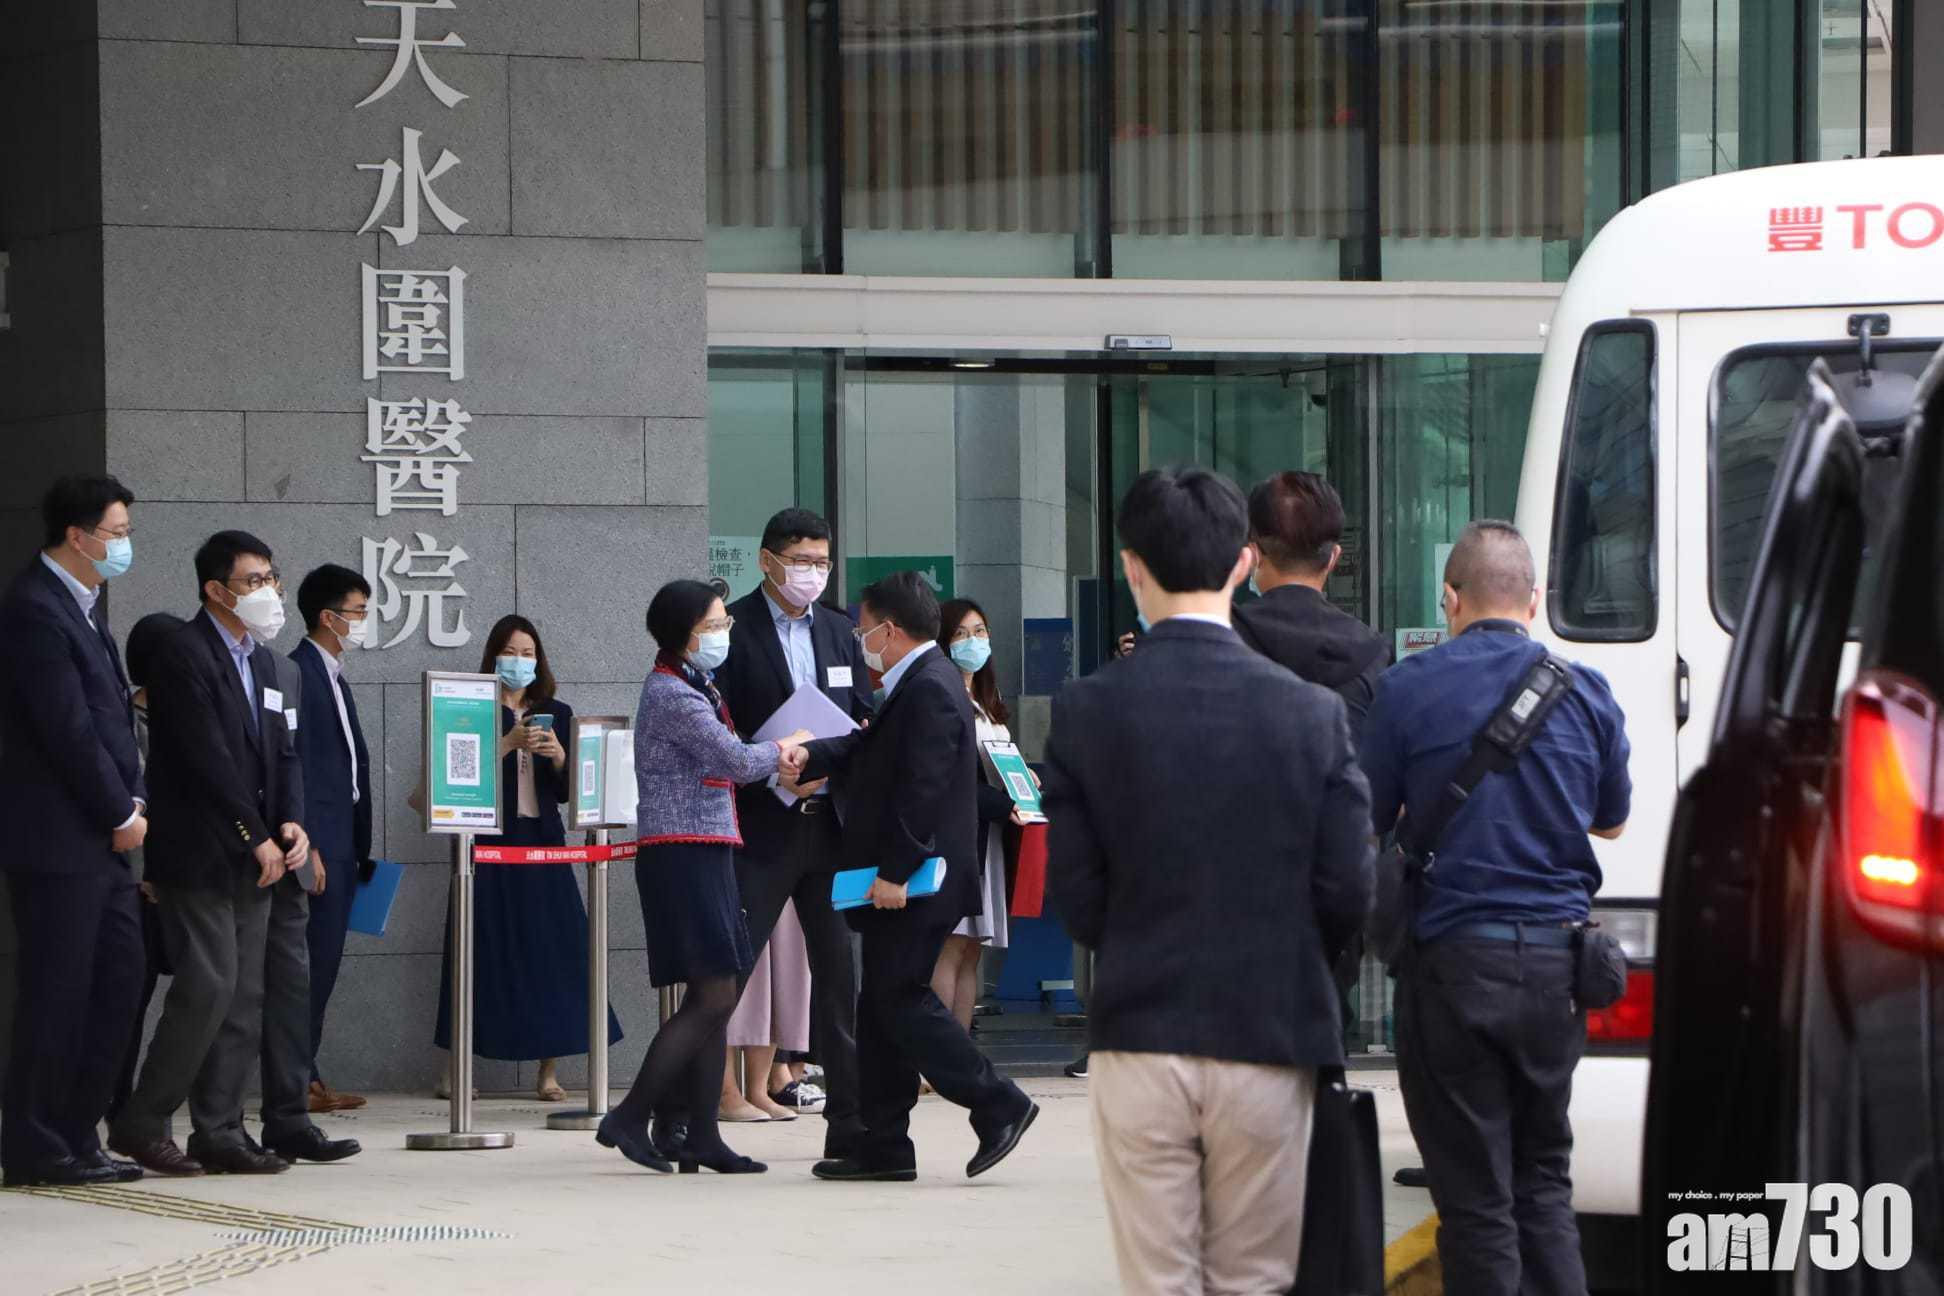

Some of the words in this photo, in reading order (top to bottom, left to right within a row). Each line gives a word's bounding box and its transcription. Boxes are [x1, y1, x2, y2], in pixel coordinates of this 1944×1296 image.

[354, 0, 474, 650] 天水圍醫院
[1836, 202, 1944, 250] TO
